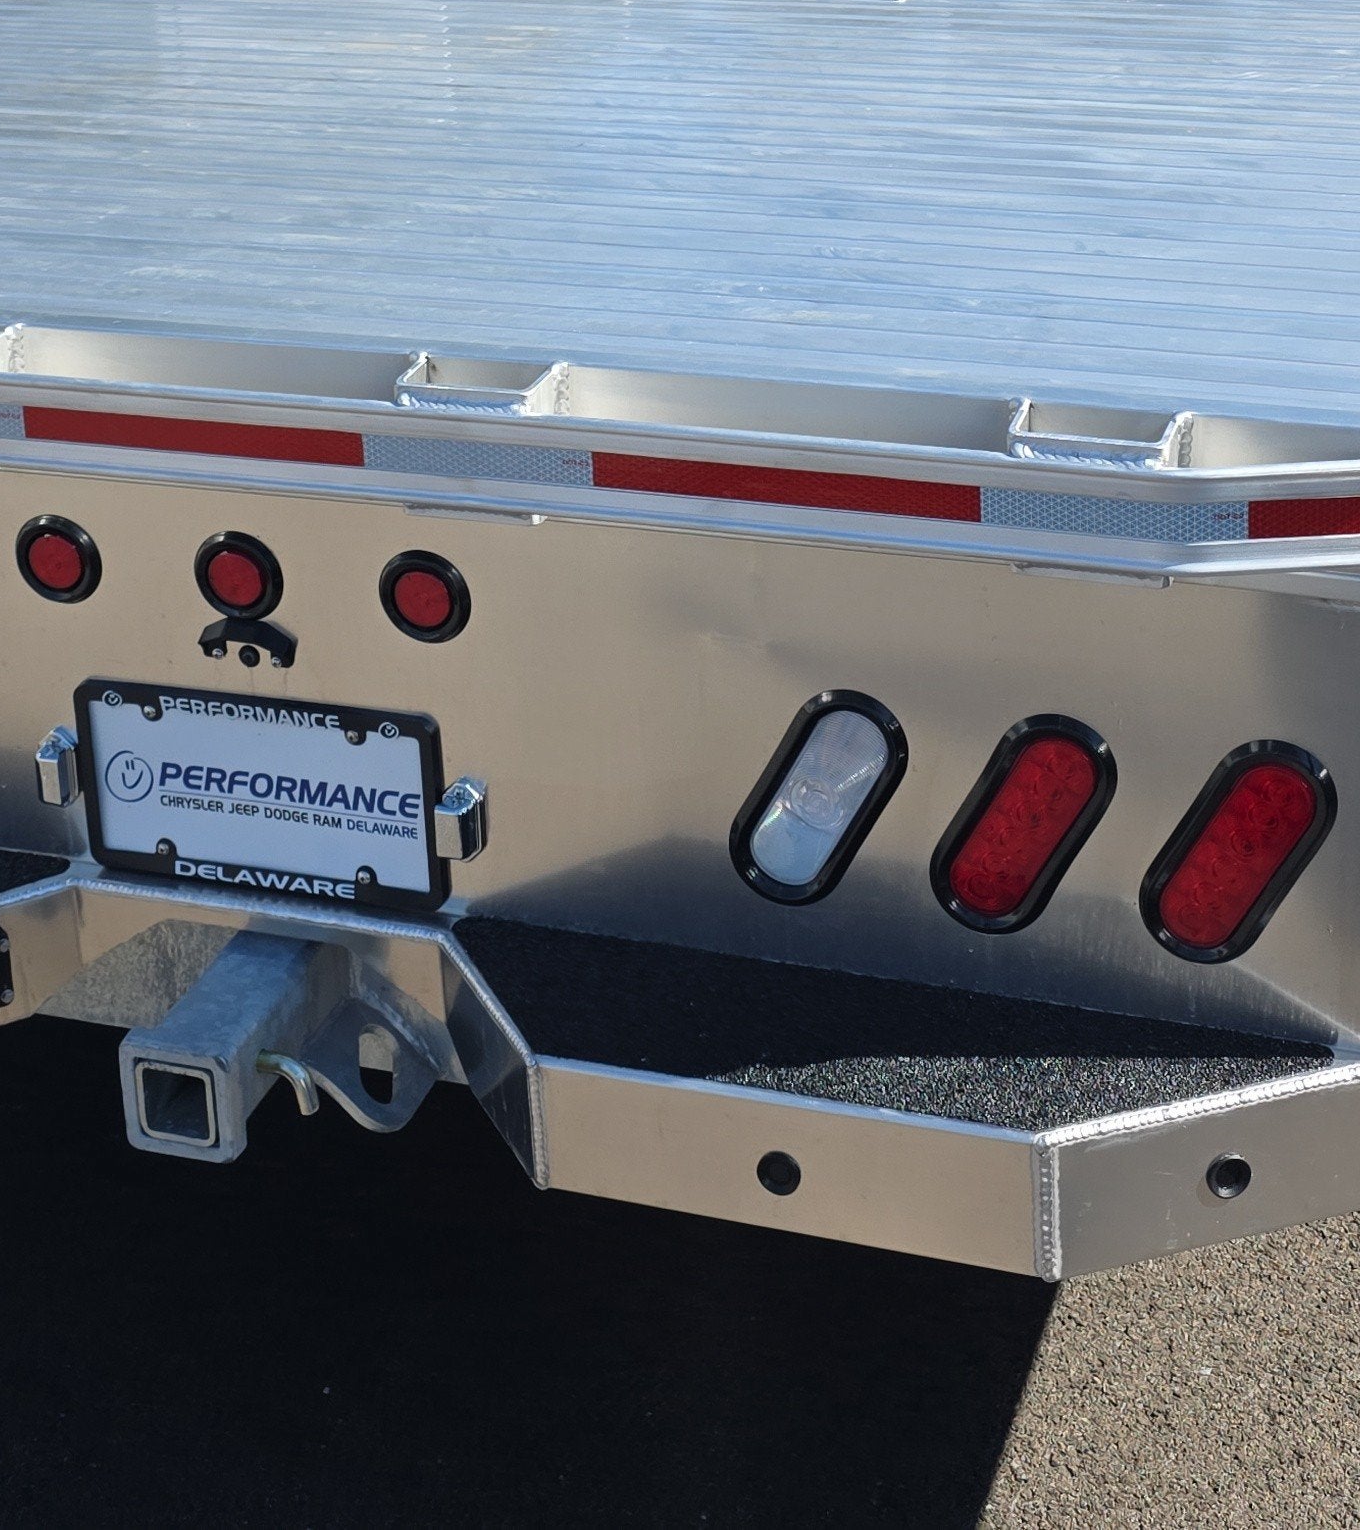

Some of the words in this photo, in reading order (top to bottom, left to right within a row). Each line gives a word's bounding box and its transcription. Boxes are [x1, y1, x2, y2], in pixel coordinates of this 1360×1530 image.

[158, 695, 341, 730] PERFORMANCE
[159, 761, 421, 819] PERFORMANCE
[160, 794, 225, 814] CHRYSLER
[228, 802, 260, 817] JEEP
[264, 807, 309, 824] DODGE
[313, 813, 342, 829] RAM
[346, 818, 419, 840] DELAWARE
[174, 859, 356, 900] DELAWARE
